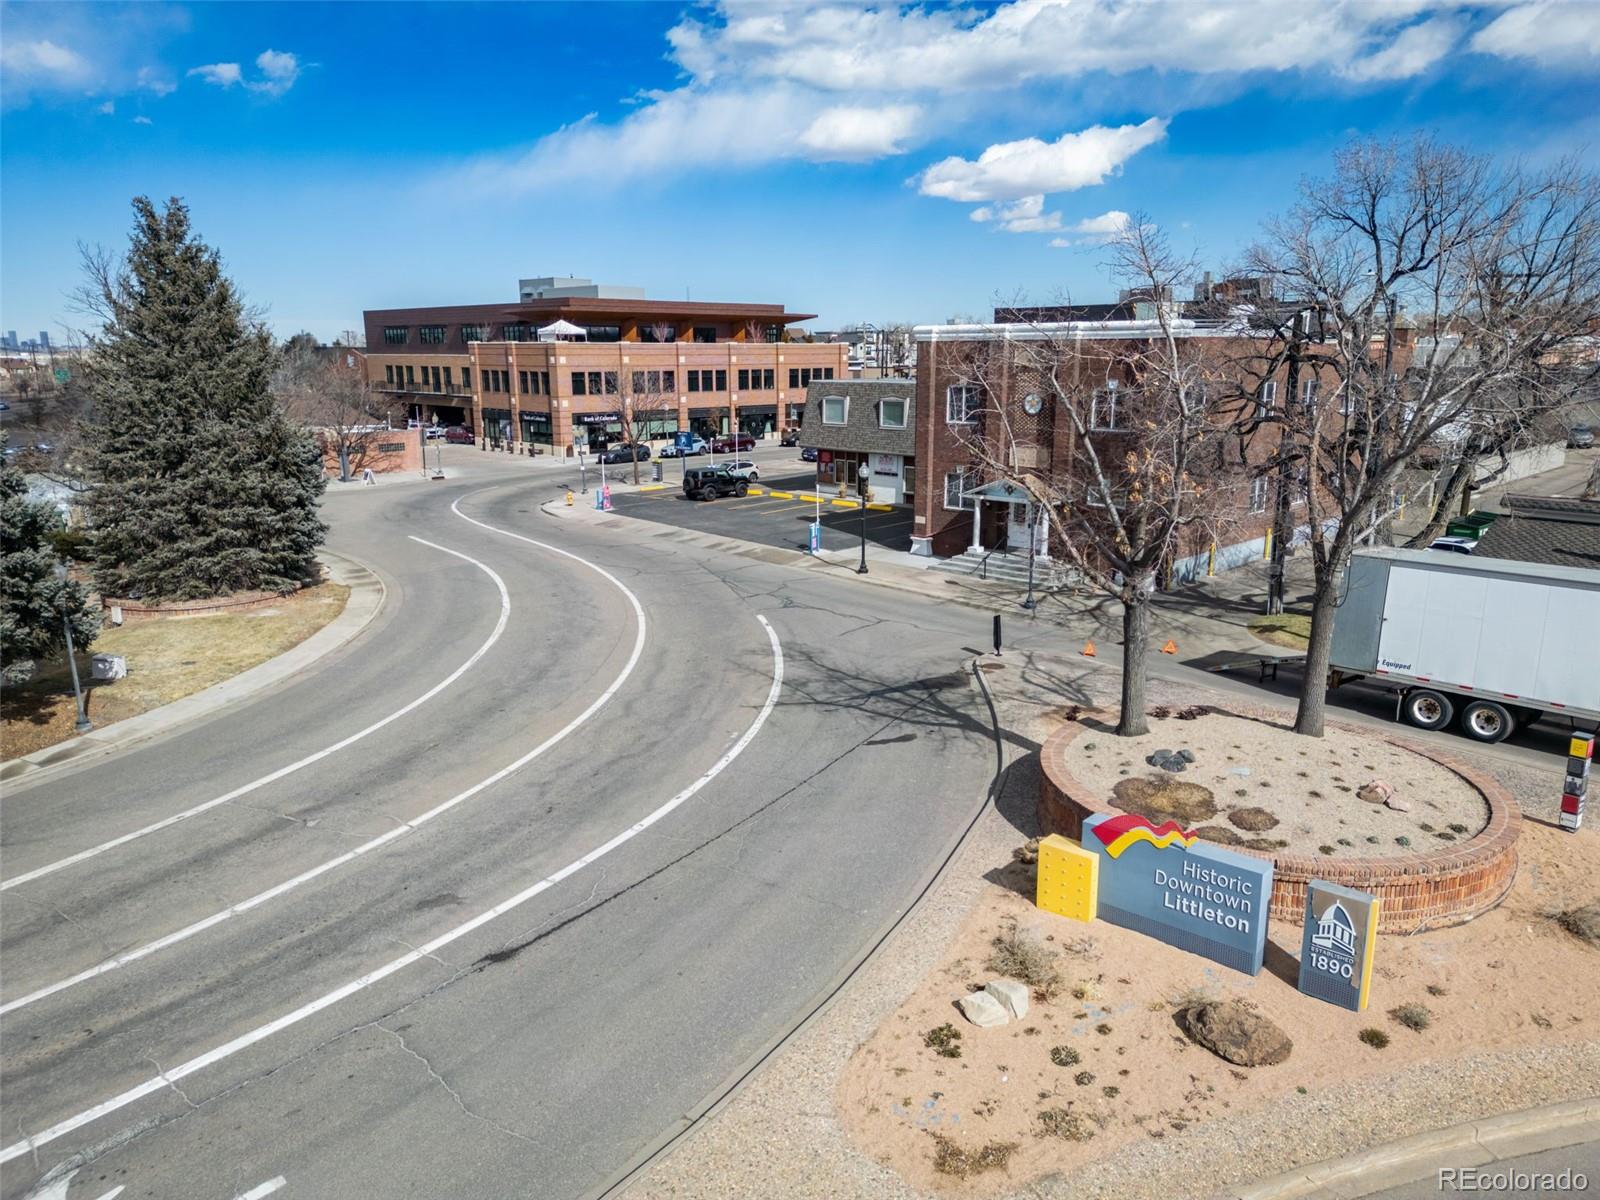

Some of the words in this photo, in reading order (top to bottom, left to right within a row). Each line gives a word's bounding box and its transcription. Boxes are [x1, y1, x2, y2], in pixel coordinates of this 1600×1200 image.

[1382, 659, 1412, 670] Equipped
[1155, 869, 1251, 913] Downtown
[1183, 860, 1252, 895] Historic
[1164, 891, 1249, 933] Littleton
[1310, 953, 1353, 978] 1890
[1311, 946, 1354, 964] ESTABLISHED
